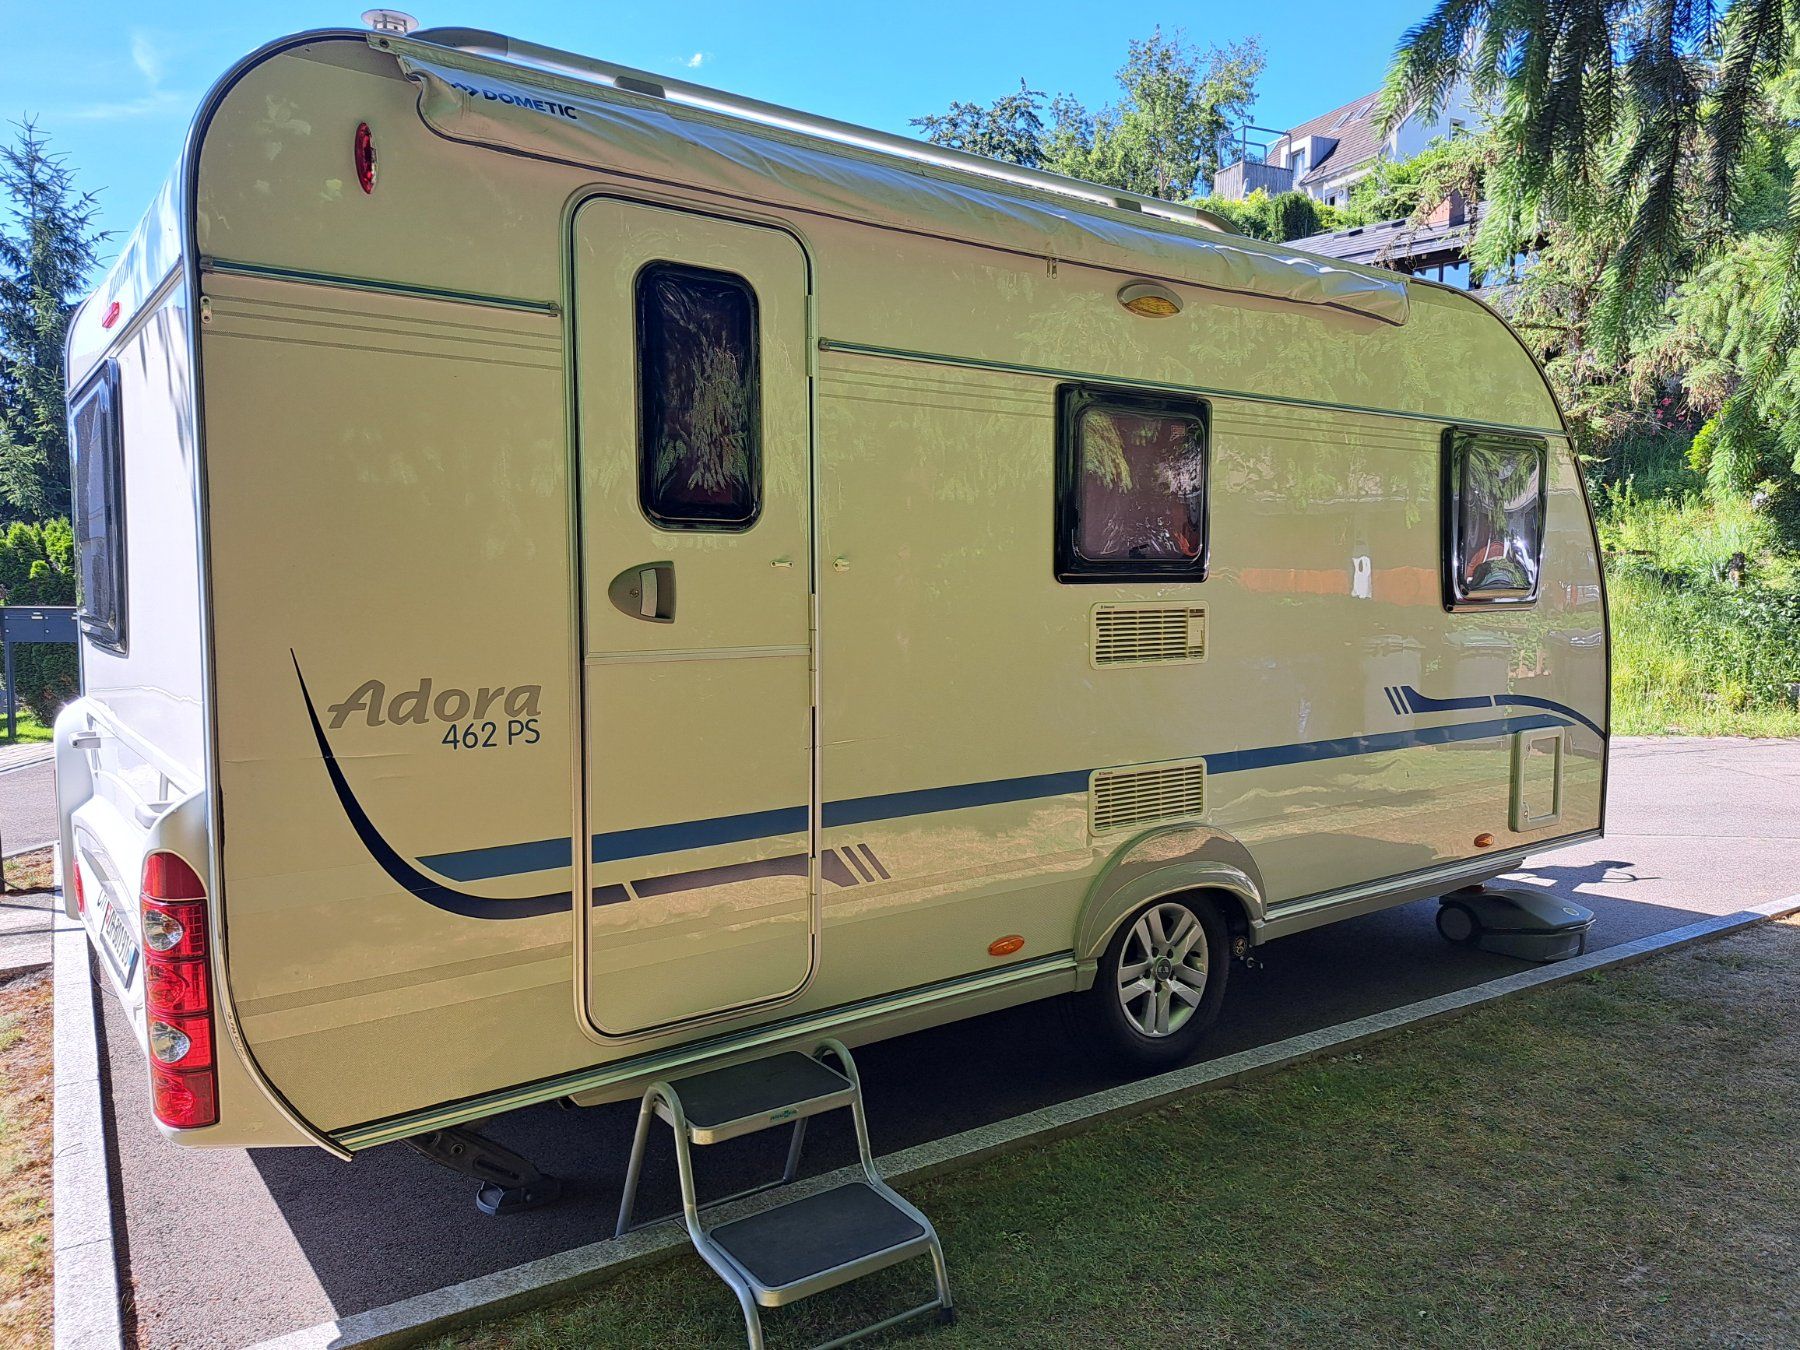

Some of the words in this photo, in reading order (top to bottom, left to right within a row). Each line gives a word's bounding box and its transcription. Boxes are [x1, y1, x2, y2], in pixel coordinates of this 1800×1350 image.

[482, 88, 578, 119] DOMETIC
[327, 678, 542, 729] Adora
[441, 721, 497, 750] 462
[508, 719, 541, 745] PS
